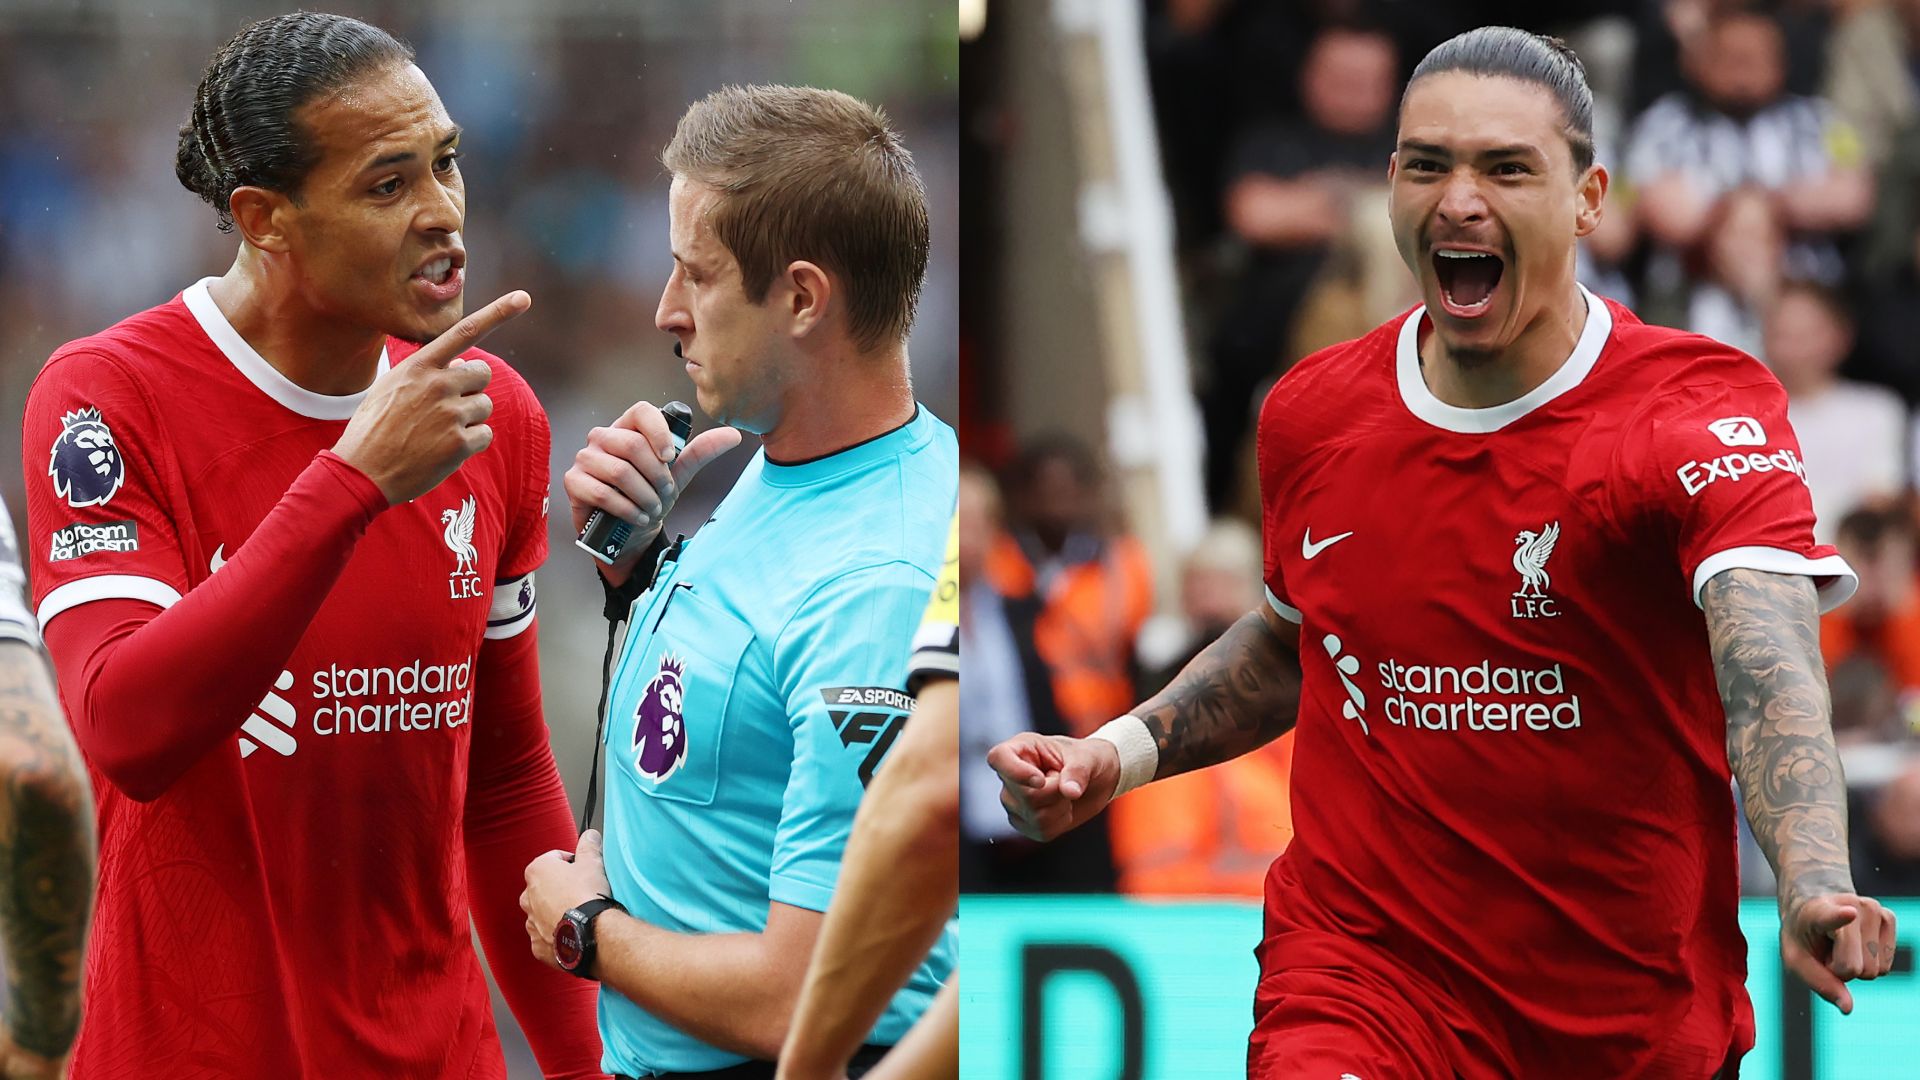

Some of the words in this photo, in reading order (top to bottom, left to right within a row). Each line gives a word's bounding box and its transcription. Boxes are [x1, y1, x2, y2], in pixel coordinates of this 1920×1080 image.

[52, 528, 75, 549] No
[74, 524, 128, 541] room
[49, 543, 76, 561] for
[76, 538, 138, 557] racism
[449, 577, 484, 599] L.F.C.
[1511, 598, 1562, 619] L.F.C.
[312, 655, 471, 699] standard
[1378, 658, 1564, 695] standard
[313, 690, 471, 735] chartered
[864, 689, 920, 712] SPORTS
[1384, 693, 1581, 731] chartered
